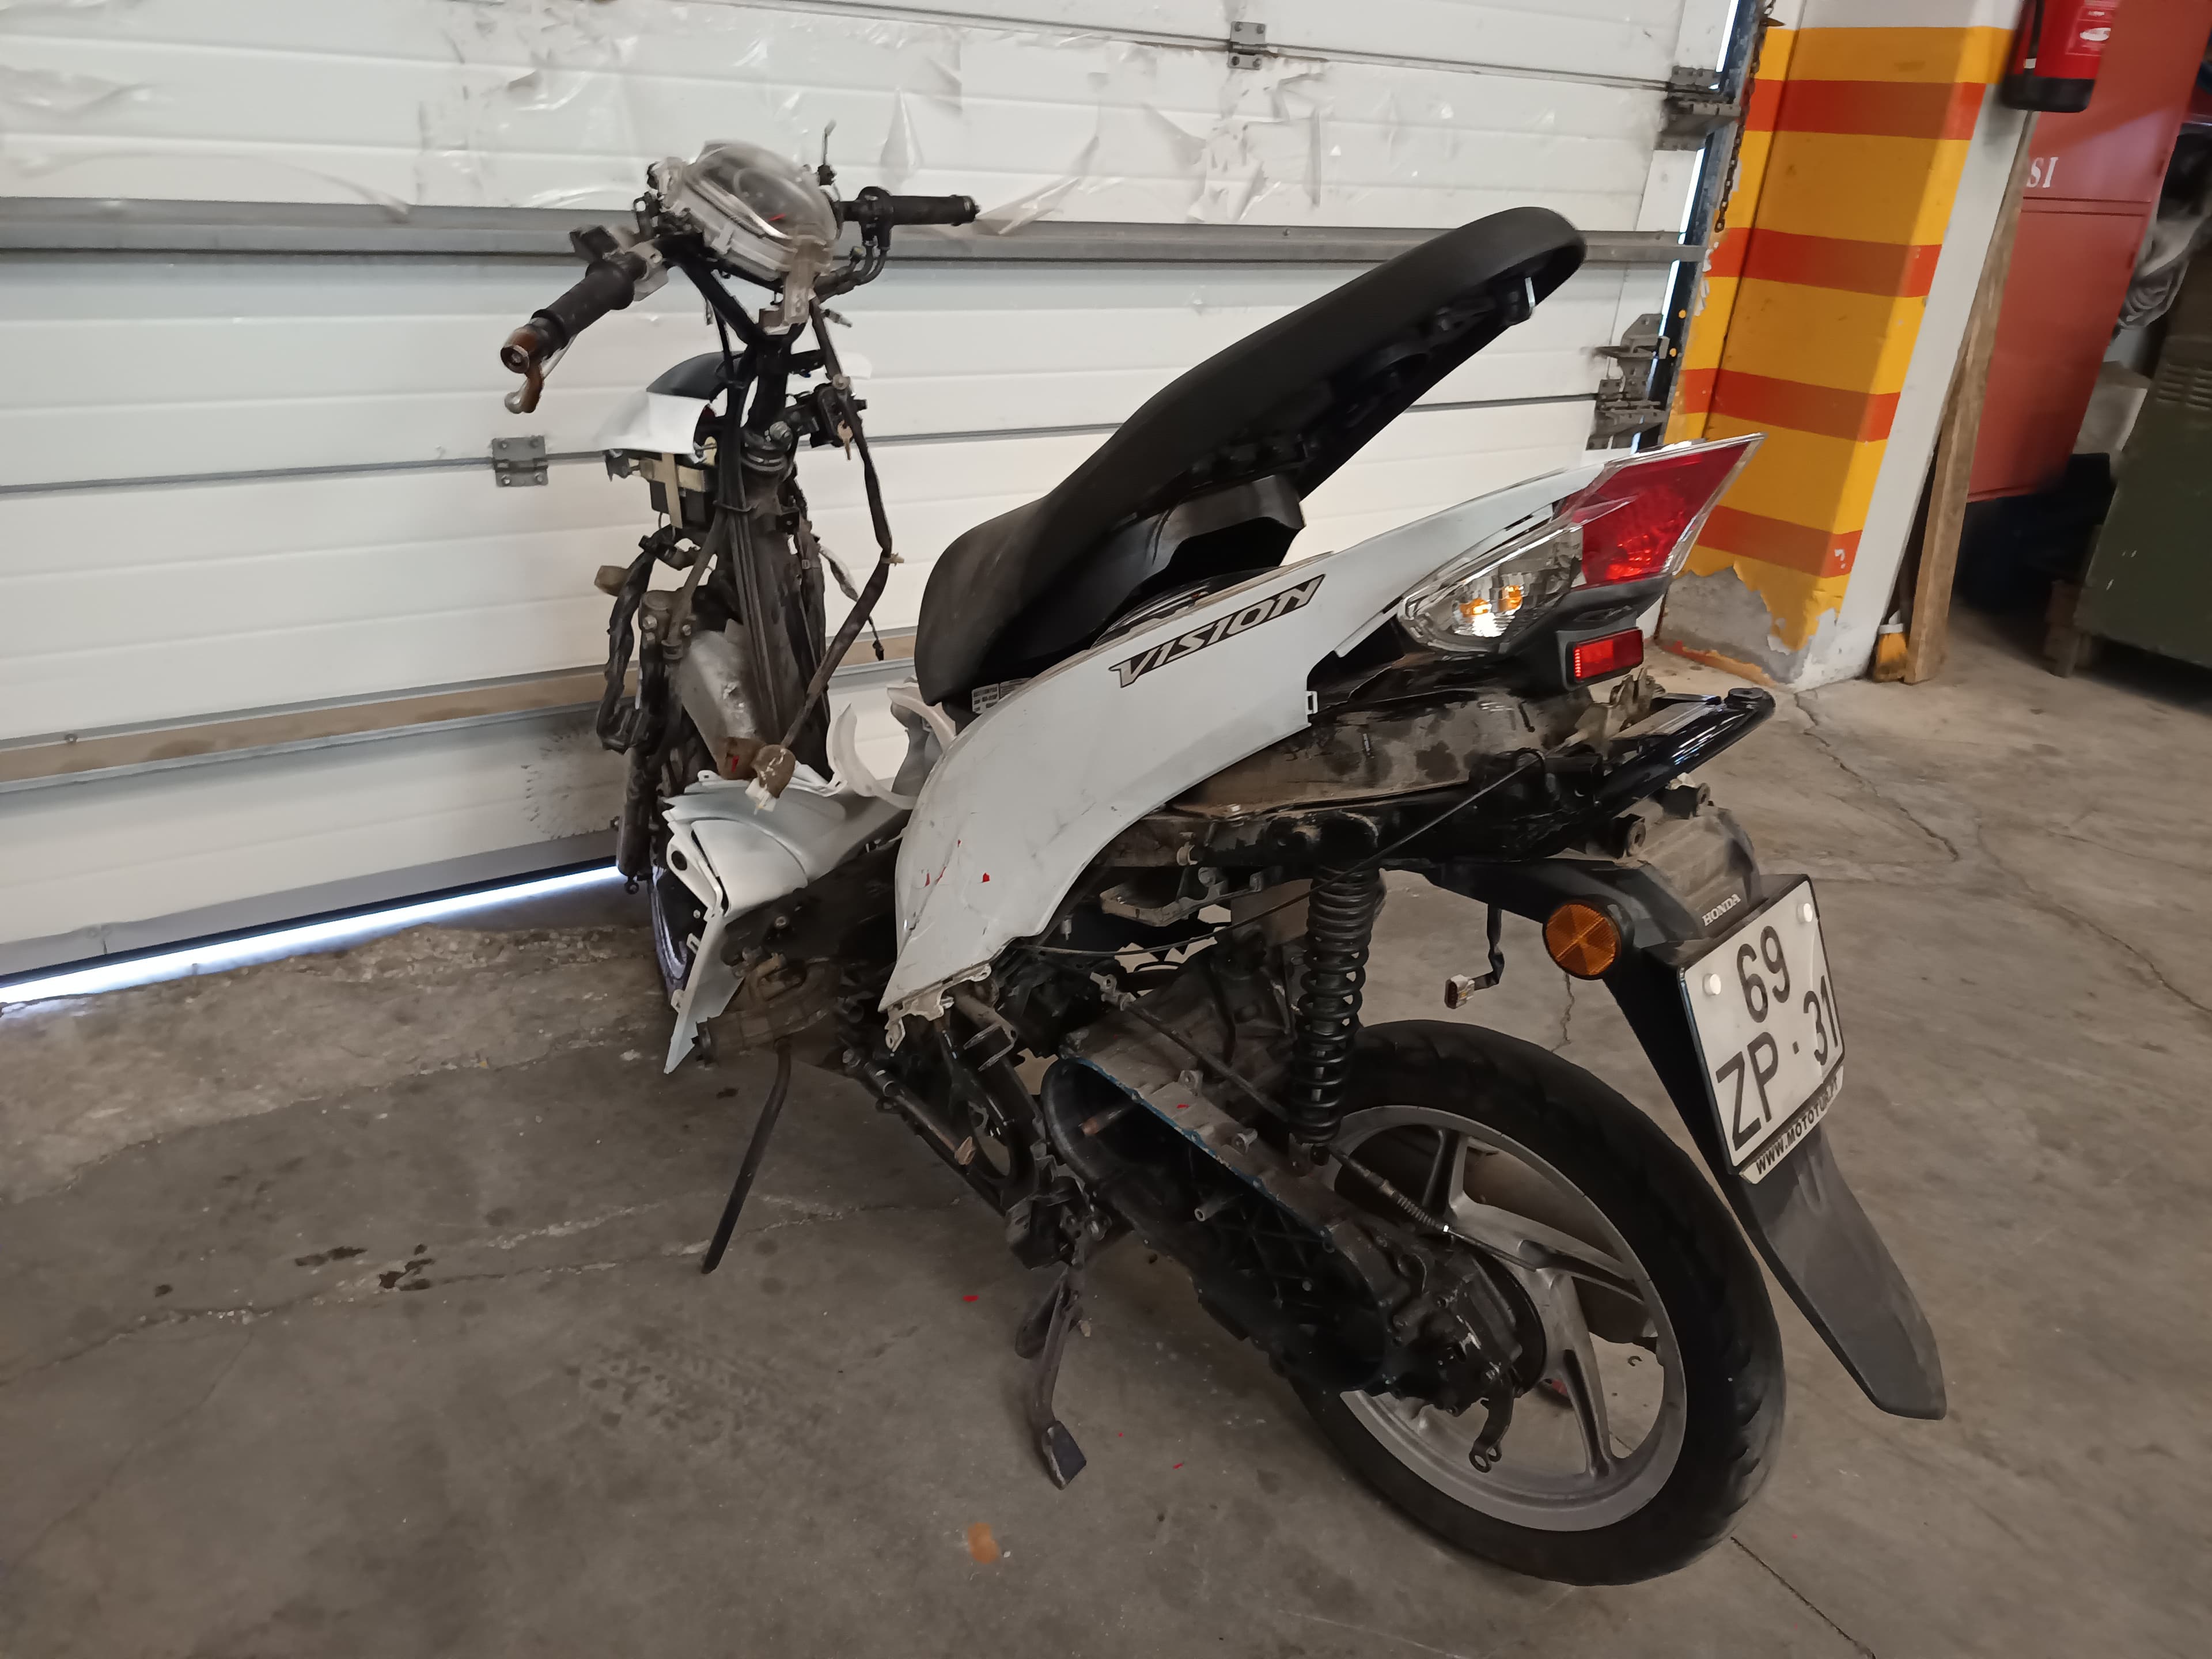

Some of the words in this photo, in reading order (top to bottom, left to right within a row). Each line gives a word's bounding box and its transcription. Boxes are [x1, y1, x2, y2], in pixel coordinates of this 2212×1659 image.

[1108, 574, 1325, 688] VISION
[1702, 893, 1741, 926] HONDA
[1736, 926, 1790, 1023] 69
